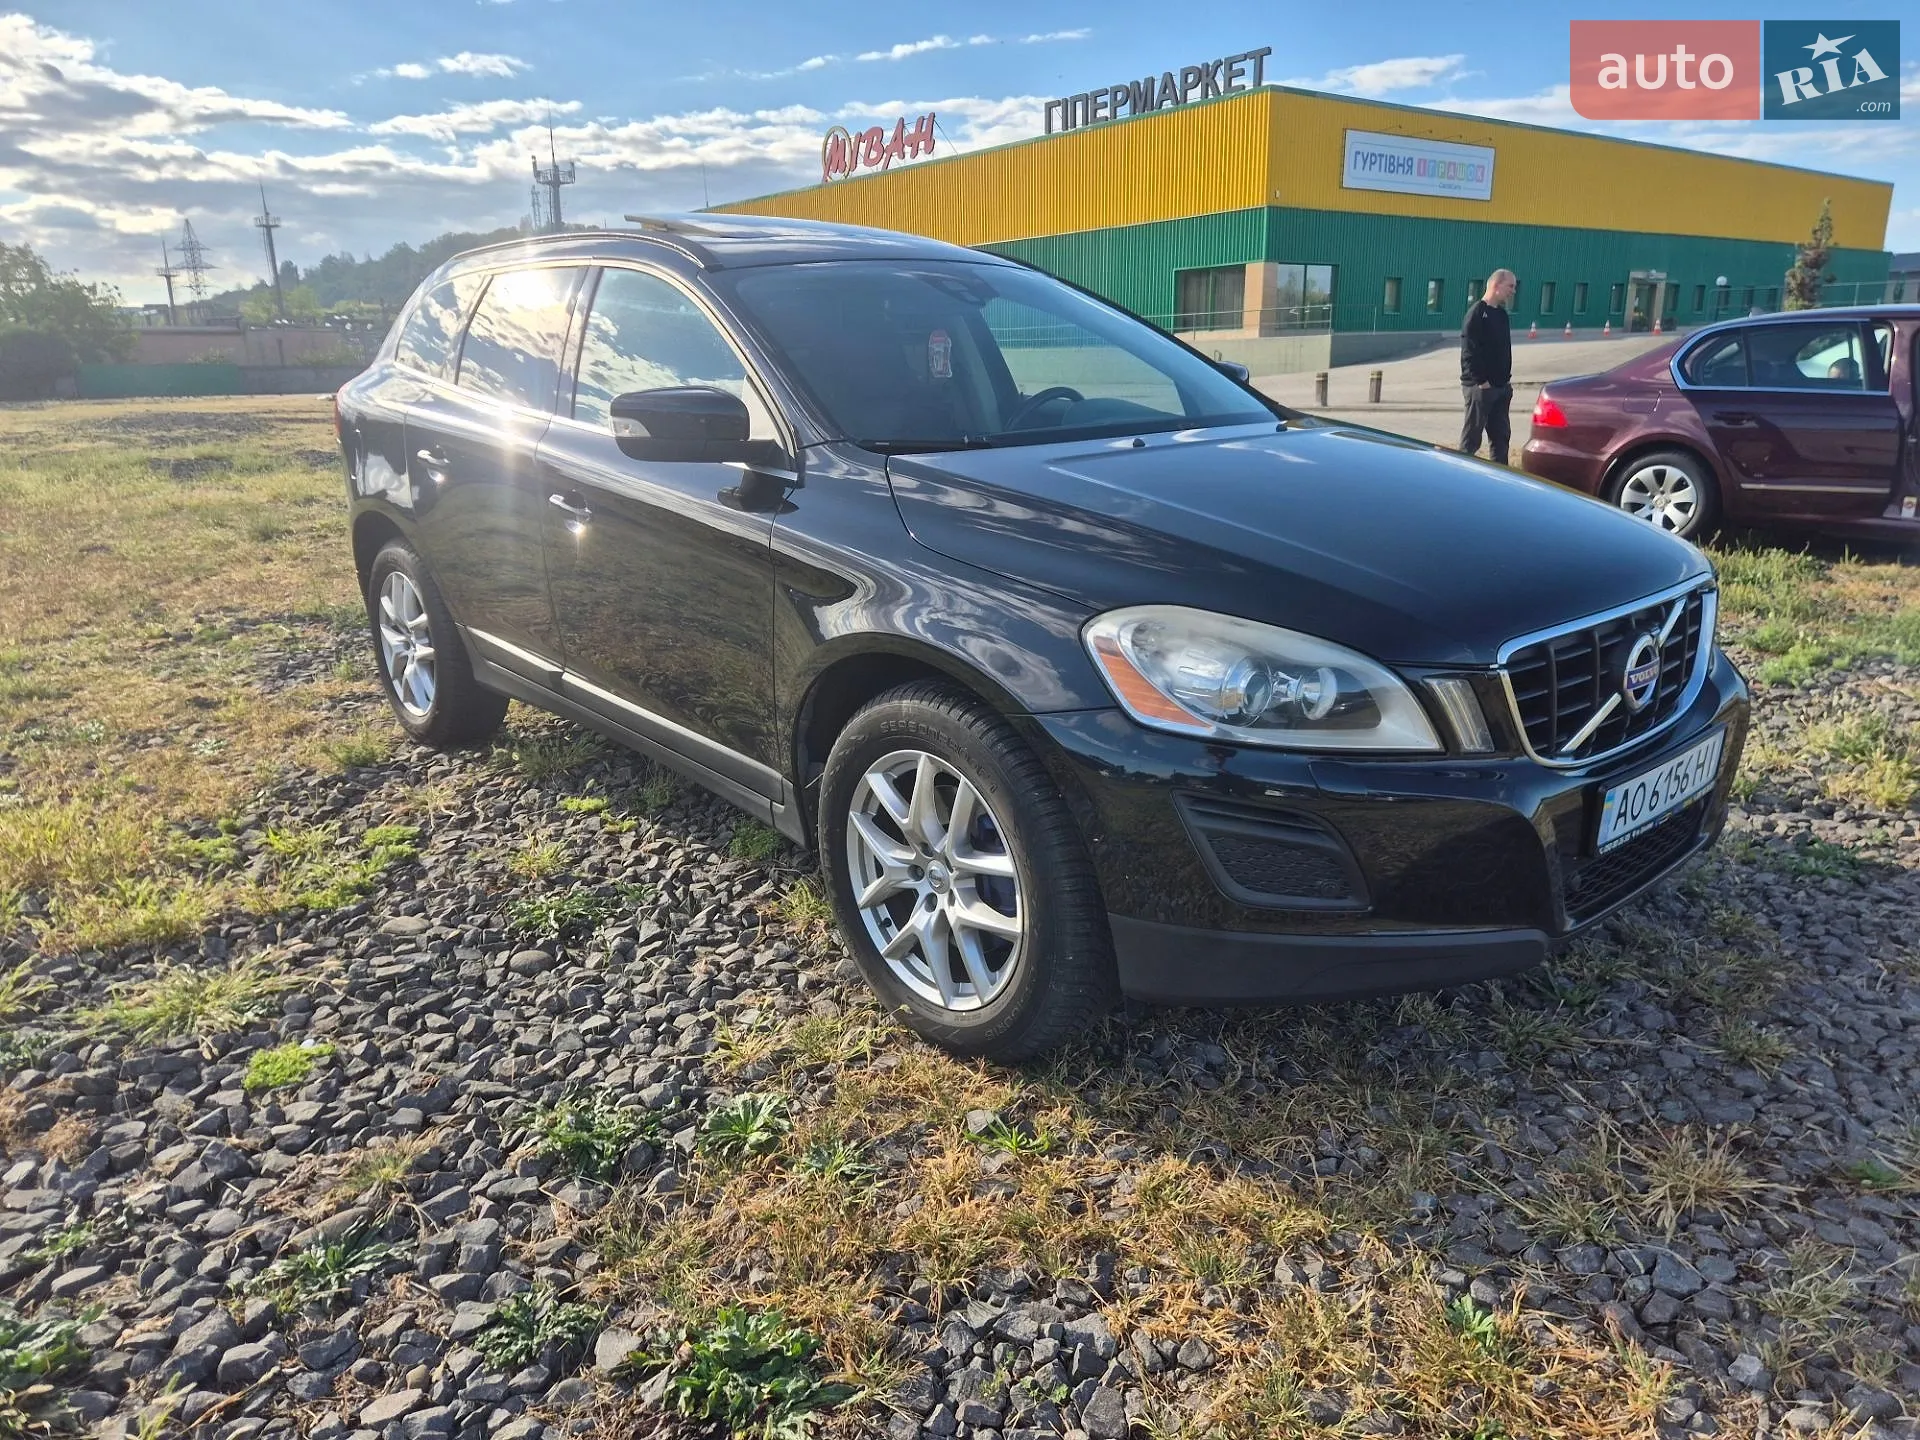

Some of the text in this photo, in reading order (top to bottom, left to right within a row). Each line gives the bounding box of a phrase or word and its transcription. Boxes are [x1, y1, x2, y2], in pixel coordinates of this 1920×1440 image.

[1044, 46, 1272, 134] ГІПЕРМАРКЕТ
[1353, 151, 1414, 176] ГУРТІВНЯ
[1648, 754, 1694, 812] 6156
